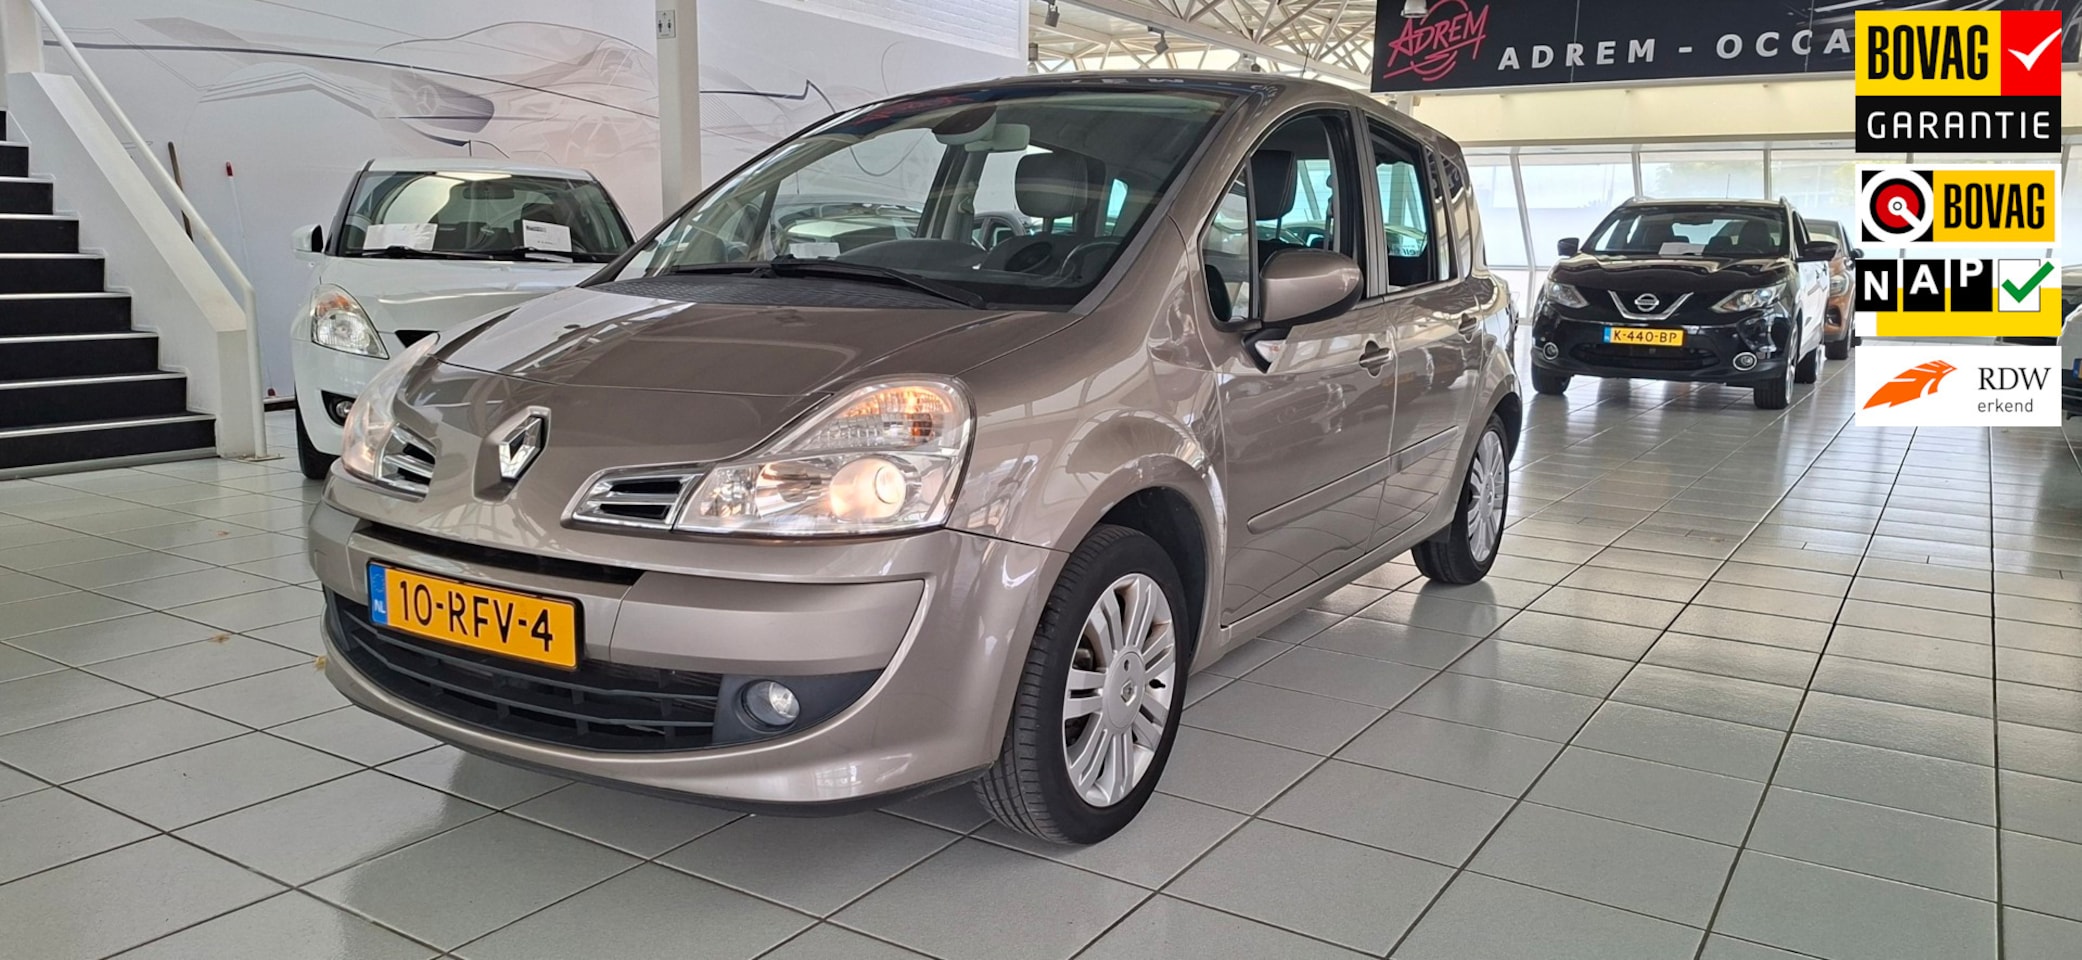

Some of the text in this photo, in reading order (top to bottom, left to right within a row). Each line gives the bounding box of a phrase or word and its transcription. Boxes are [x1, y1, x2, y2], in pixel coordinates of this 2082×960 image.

[1387, 5, 1489, 67] ADREM
[1498, 39, 1655, 70] ADREM
[1716, 28, 1851, 60] OCCA
[1614, 330, 1677, 343] K-440-BP
[374, 599, 386, 614] NL
[400, 580, 553, 652] 10-RFV-4
